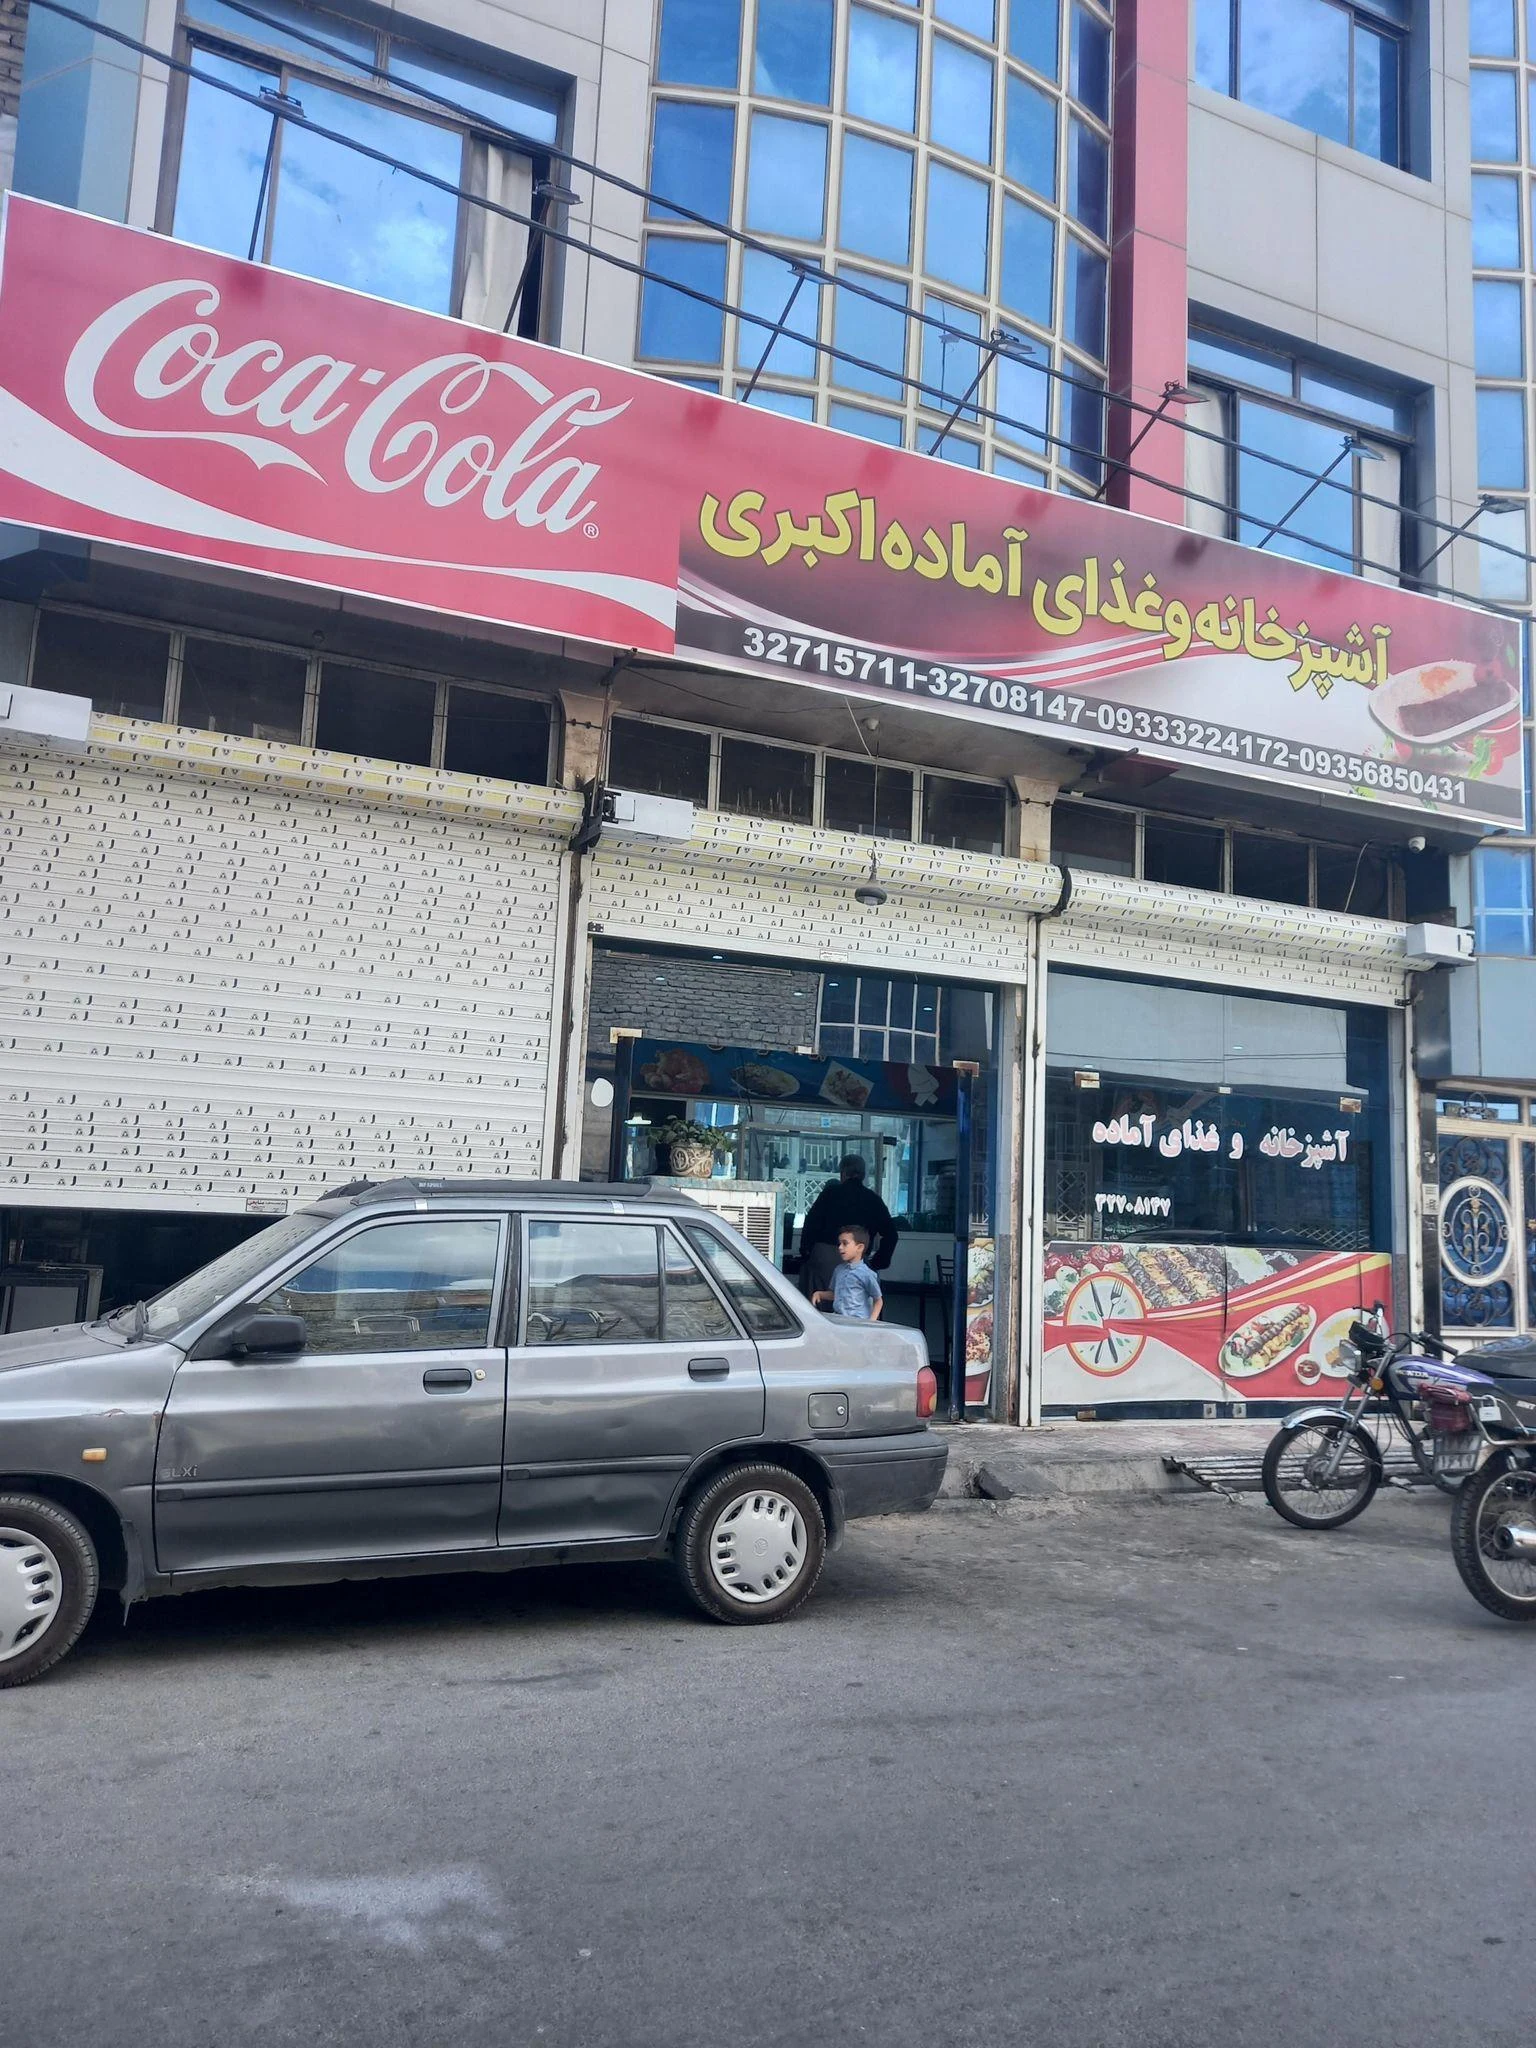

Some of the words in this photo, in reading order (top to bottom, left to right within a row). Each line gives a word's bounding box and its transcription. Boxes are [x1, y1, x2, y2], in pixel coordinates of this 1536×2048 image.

[64, 279, 634, 534] Coca-Cola
[699, 488, 877, 569] اکبری
[880, 520, 1029, 597] آماده
[1032, 557, 1164, 636] غذای
[1162, 599, 1193, 660] و
[1194, 595, 1392, 700] آشپزخانه
[1093, 1114, 1156, 1148] آماده
[1159, 1119, 1220, 1157] غذای
[1229, 1132, 1244, 1159] و
[1260, 1126, 1350, 1170] آشپزخانه
